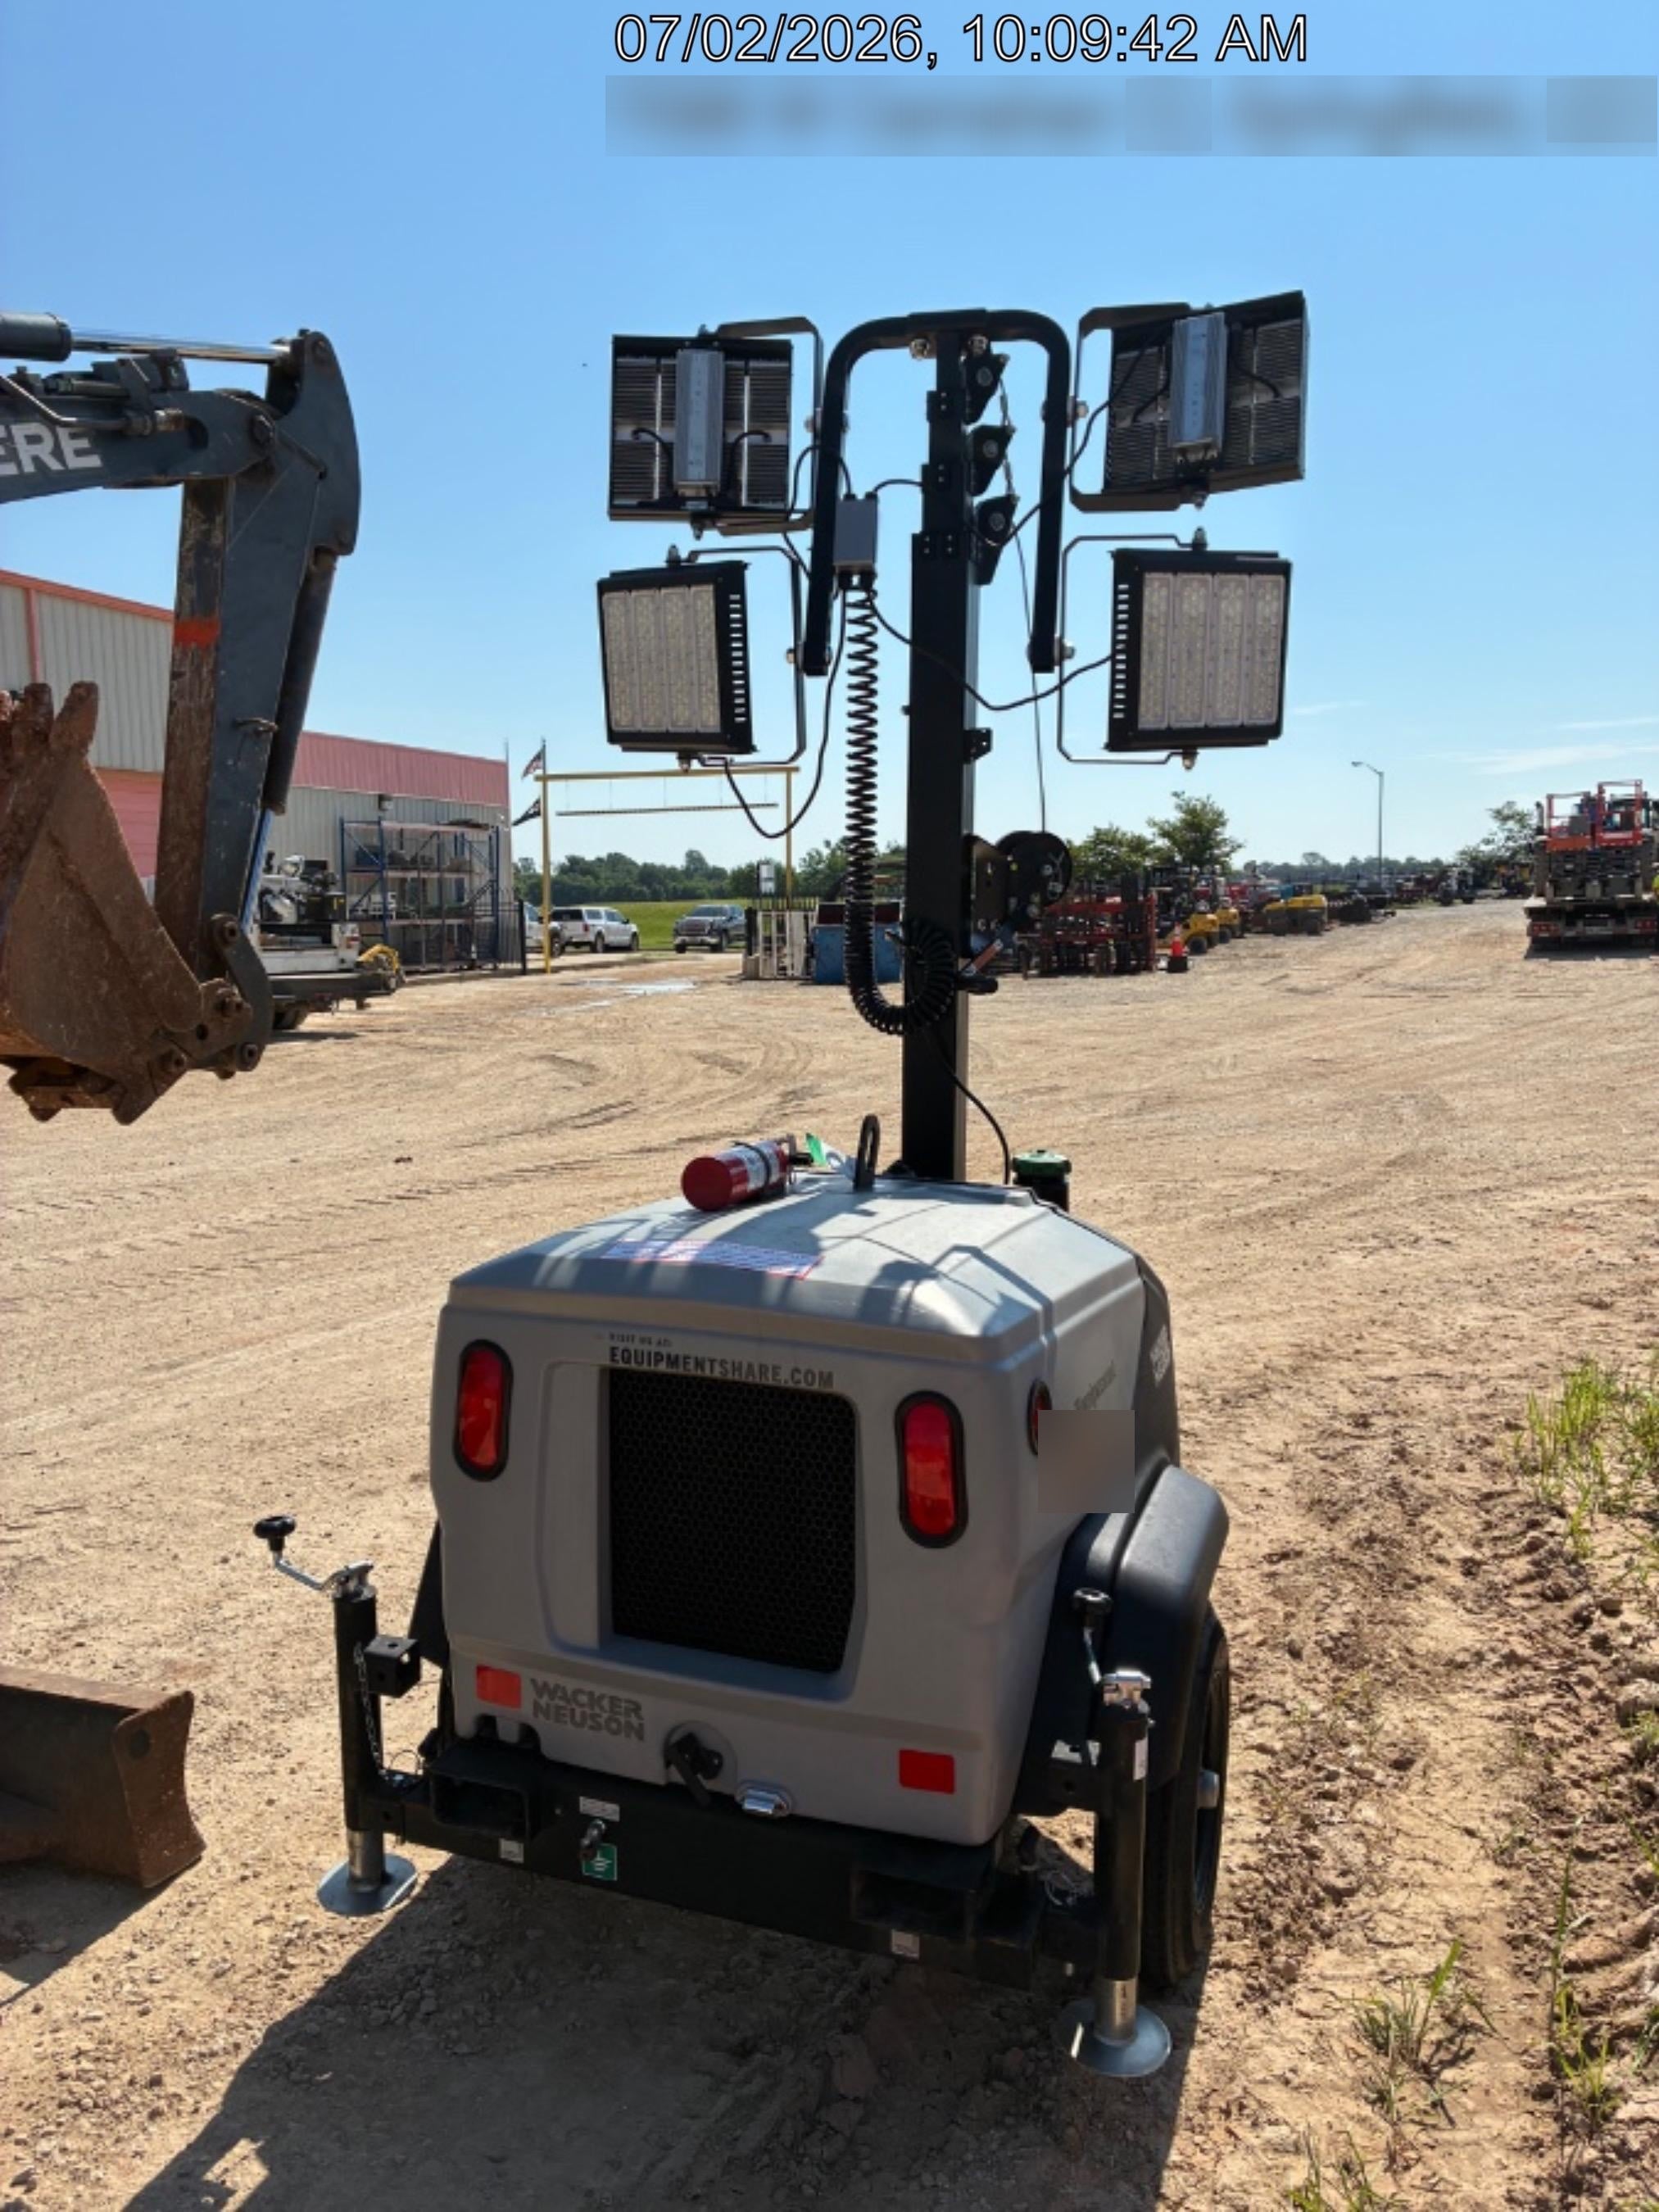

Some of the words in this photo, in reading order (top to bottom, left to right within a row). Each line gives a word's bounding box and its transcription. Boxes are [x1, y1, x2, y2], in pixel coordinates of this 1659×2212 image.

[609, 1346, 834, 1389] EQUIPMENTSHARE.COM
[531, 1678, 644, 1721] WACKER
[533, 1698, 644, 1742] NEUSON
